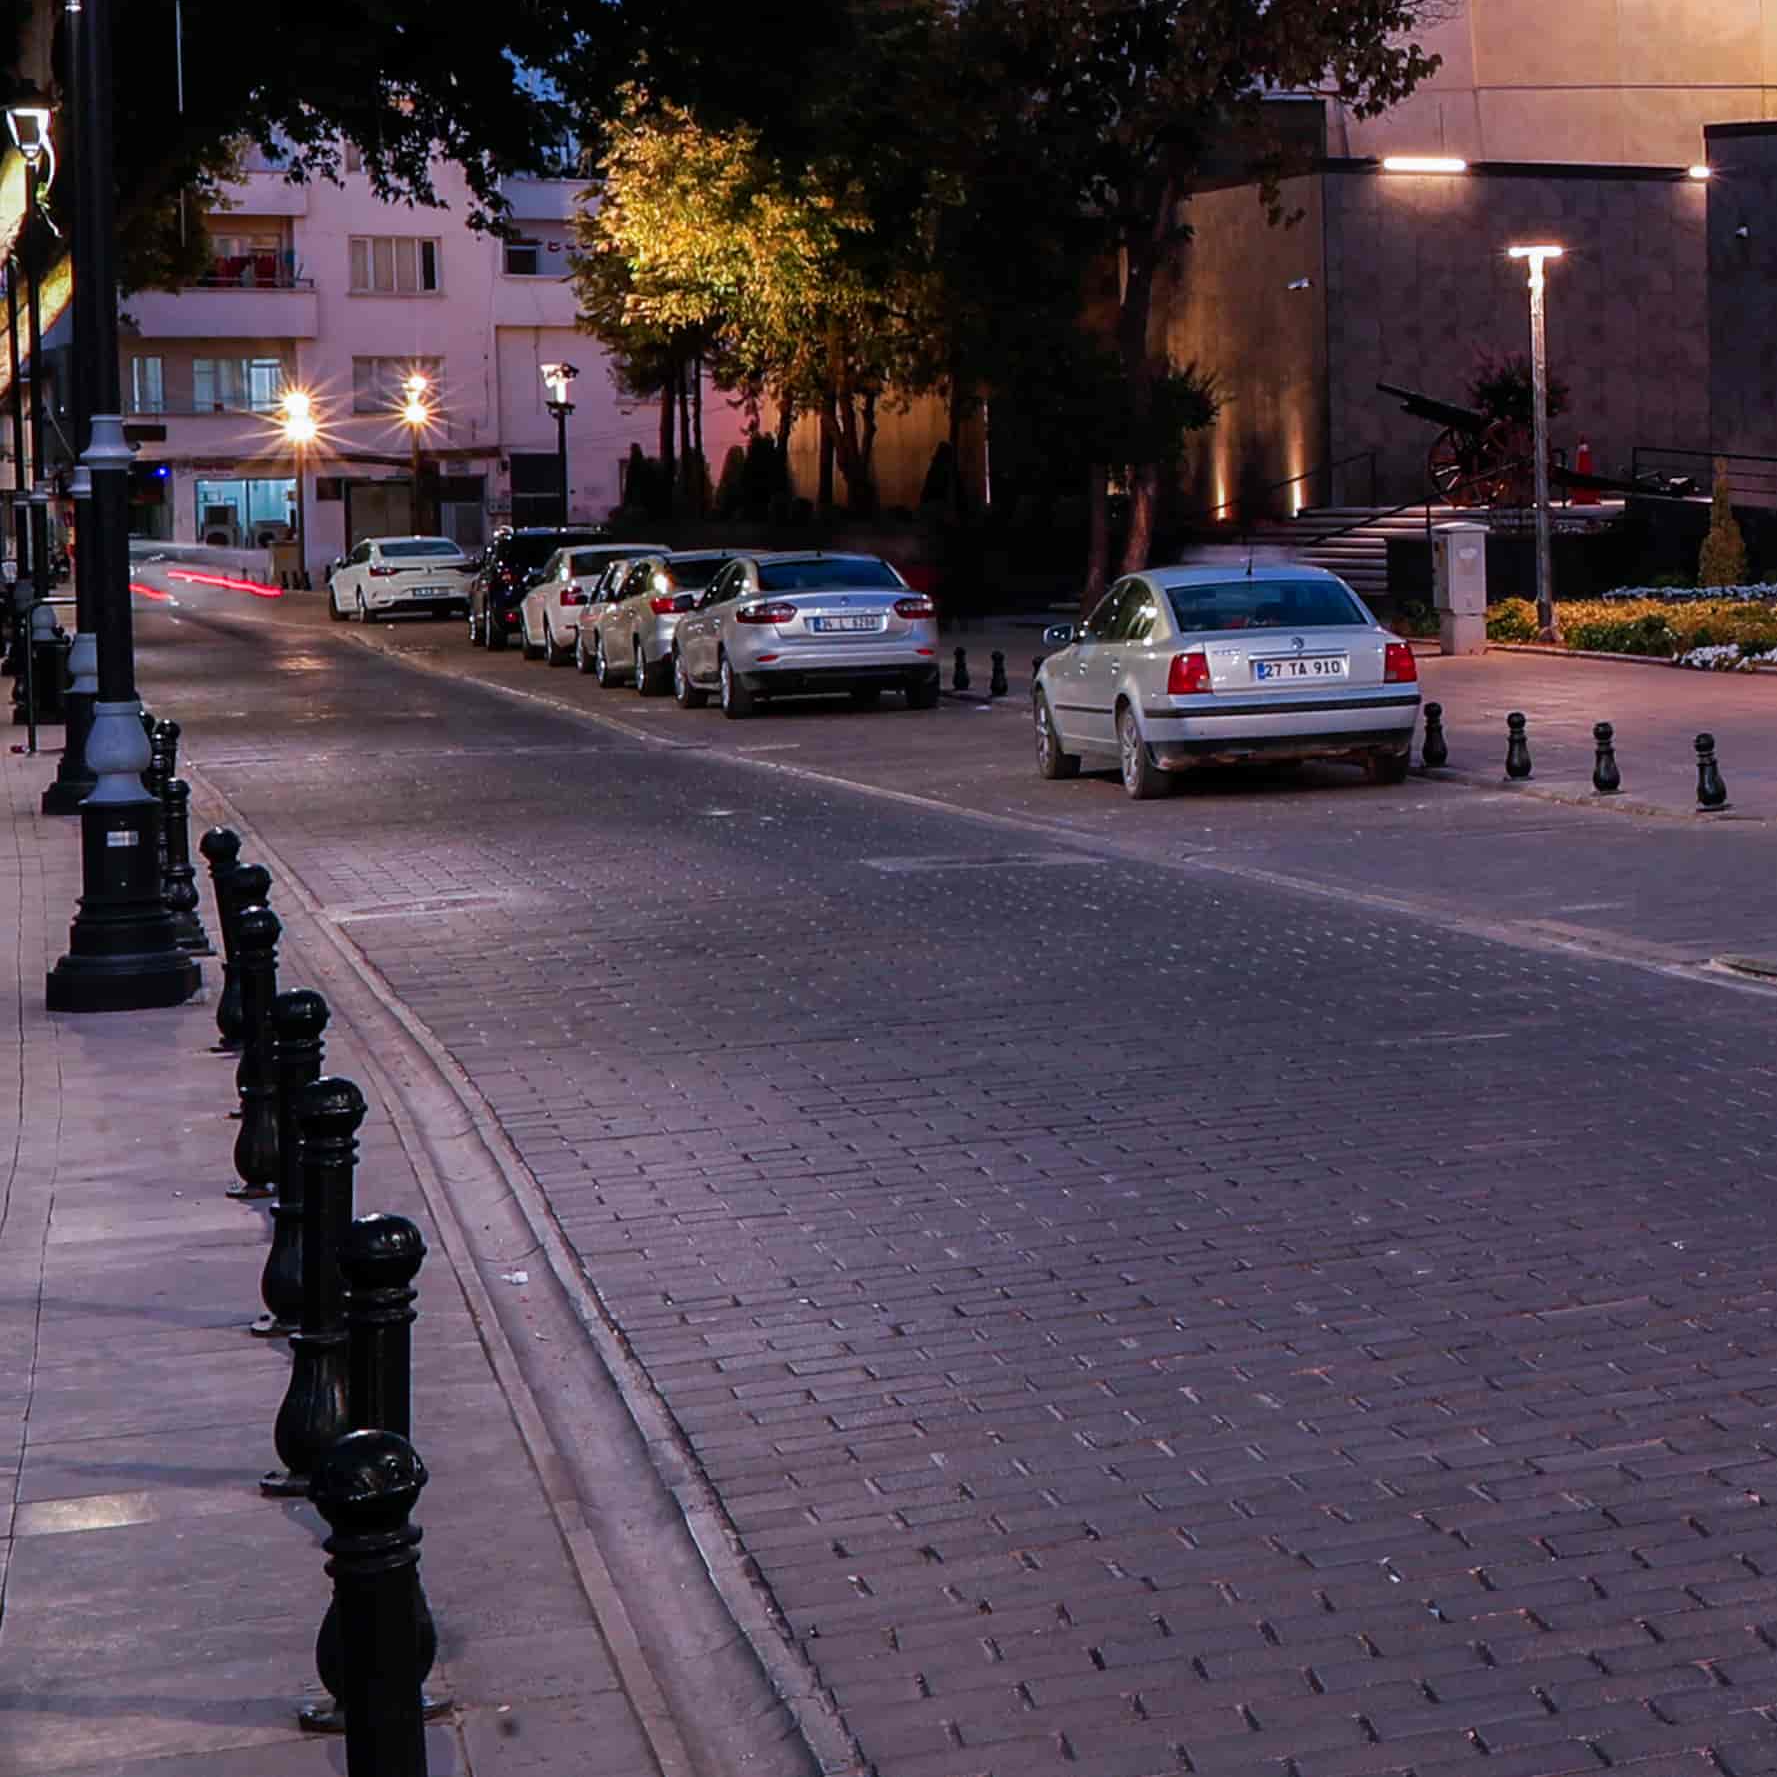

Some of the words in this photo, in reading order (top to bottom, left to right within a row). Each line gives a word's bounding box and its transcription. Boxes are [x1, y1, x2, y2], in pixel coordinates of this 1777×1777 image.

[1265, 663, 1282, 677] 27
[1289, 662, 1307, 676] TA
[1313, 660, 1340, 673] 910
